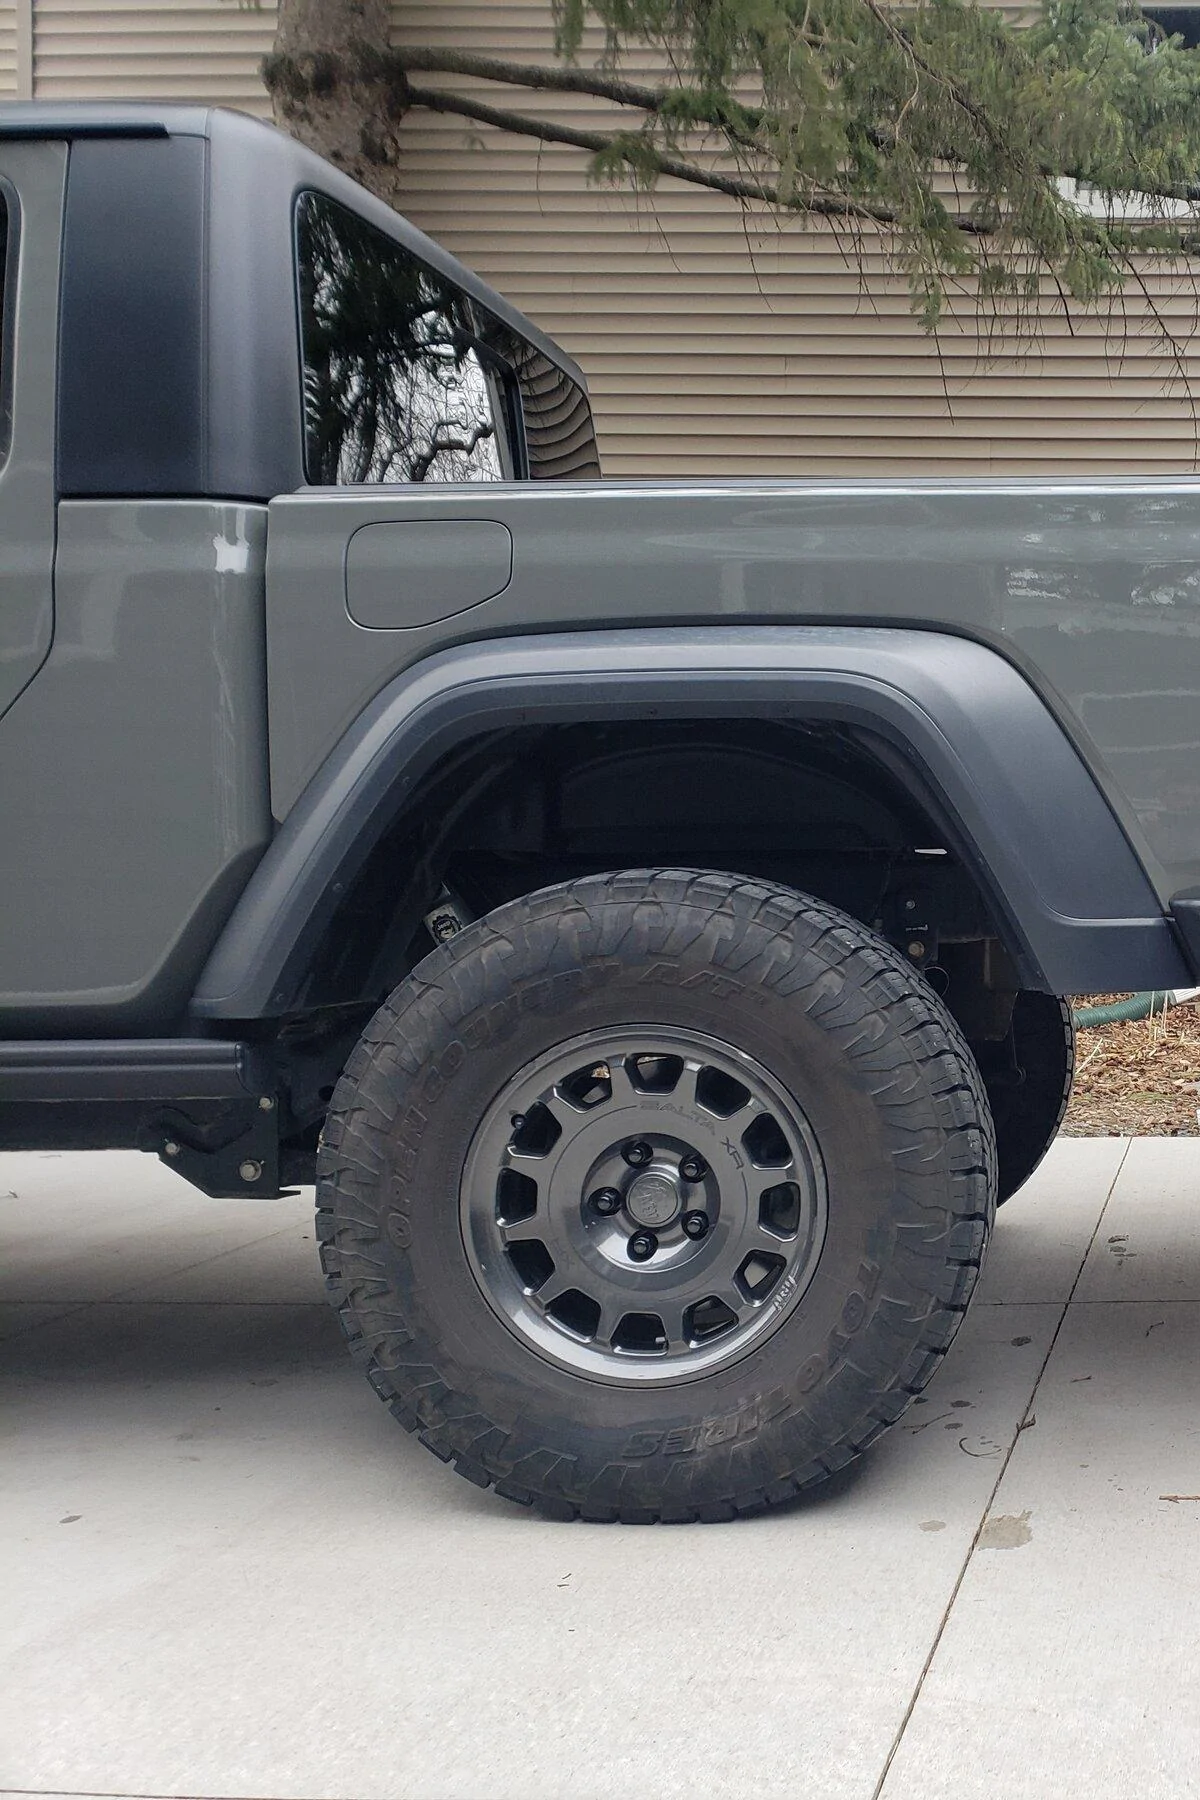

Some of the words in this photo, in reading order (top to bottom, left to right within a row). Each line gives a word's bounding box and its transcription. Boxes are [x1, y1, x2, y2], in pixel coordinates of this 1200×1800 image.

[388, 1105, 428, 1249] OPEN
[719, 1135, 745, 1170] XR
[796, 1260, 881, 1395] TOYO
[621, 1385, 793, 1458] TIRES
